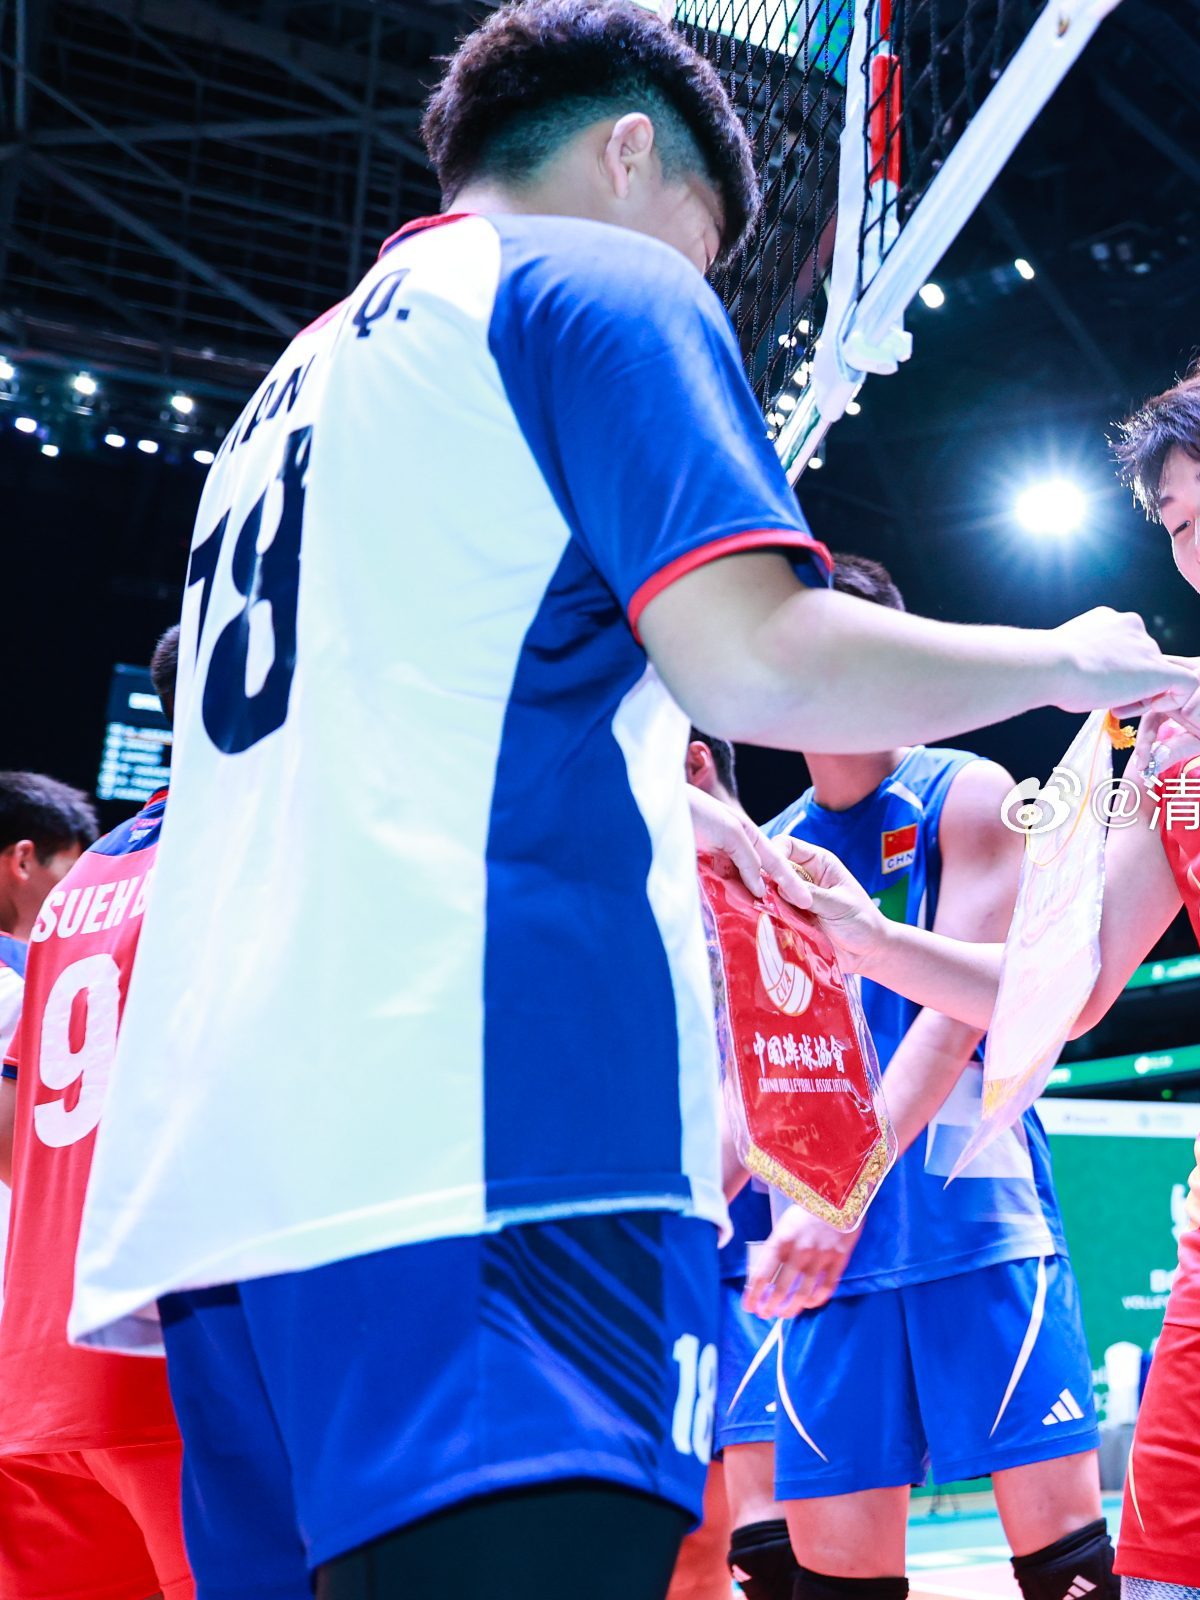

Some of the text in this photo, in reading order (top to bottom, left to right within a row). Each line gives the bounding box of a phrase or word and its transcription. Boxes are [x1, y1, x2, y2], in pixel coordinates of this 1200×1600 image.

[887, 853, 913, 868] CHN
[34, 953, 121, 1148] 9
[779, 1078, 815, 1092] VOLLEYBALL
[672, 1332, 718, 1465] 18
